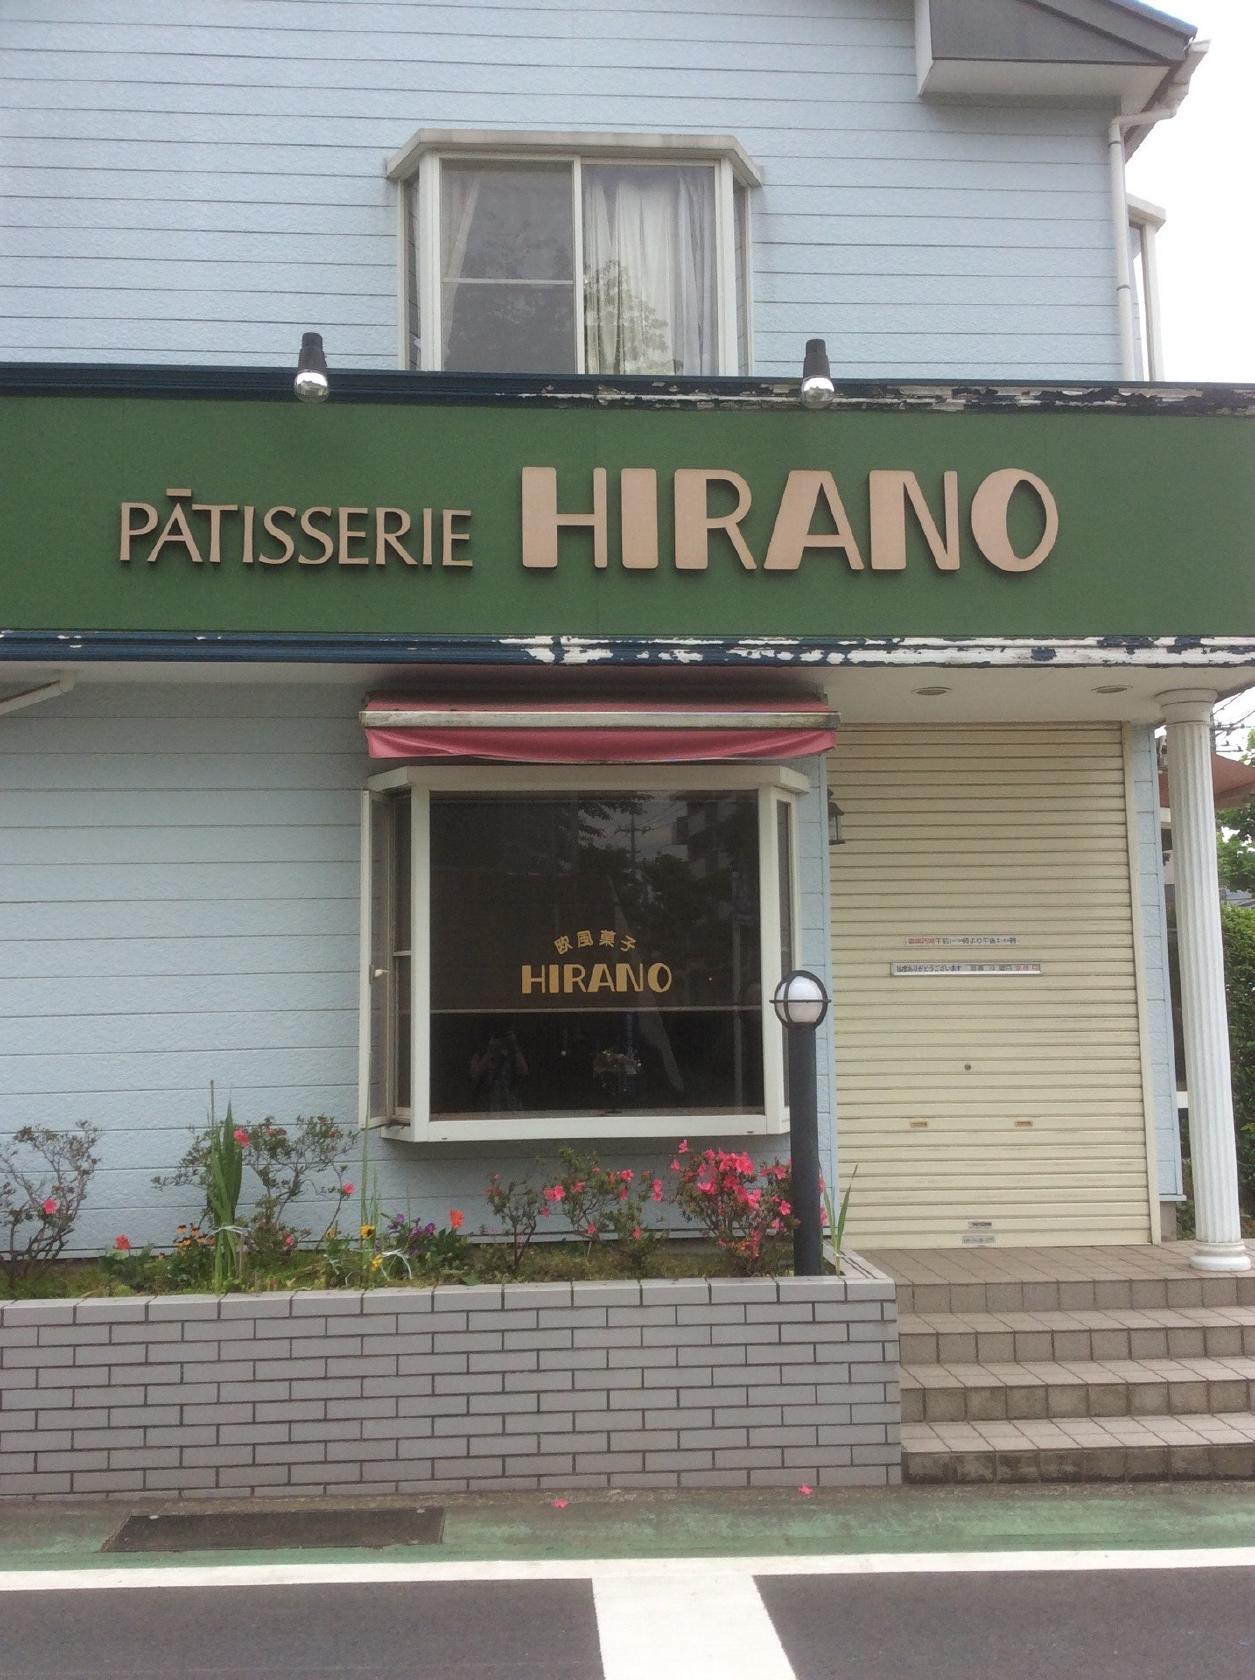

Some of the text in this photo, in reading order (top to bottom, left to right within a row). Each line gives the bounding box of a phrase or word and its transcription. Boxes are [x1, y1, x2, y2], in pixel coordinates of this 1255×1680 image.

[521, 466, 1059, 572] HIRANO
[553, 929, 638, 955] 欧風菓子
[521, 962, 673, 994] HIRANO
